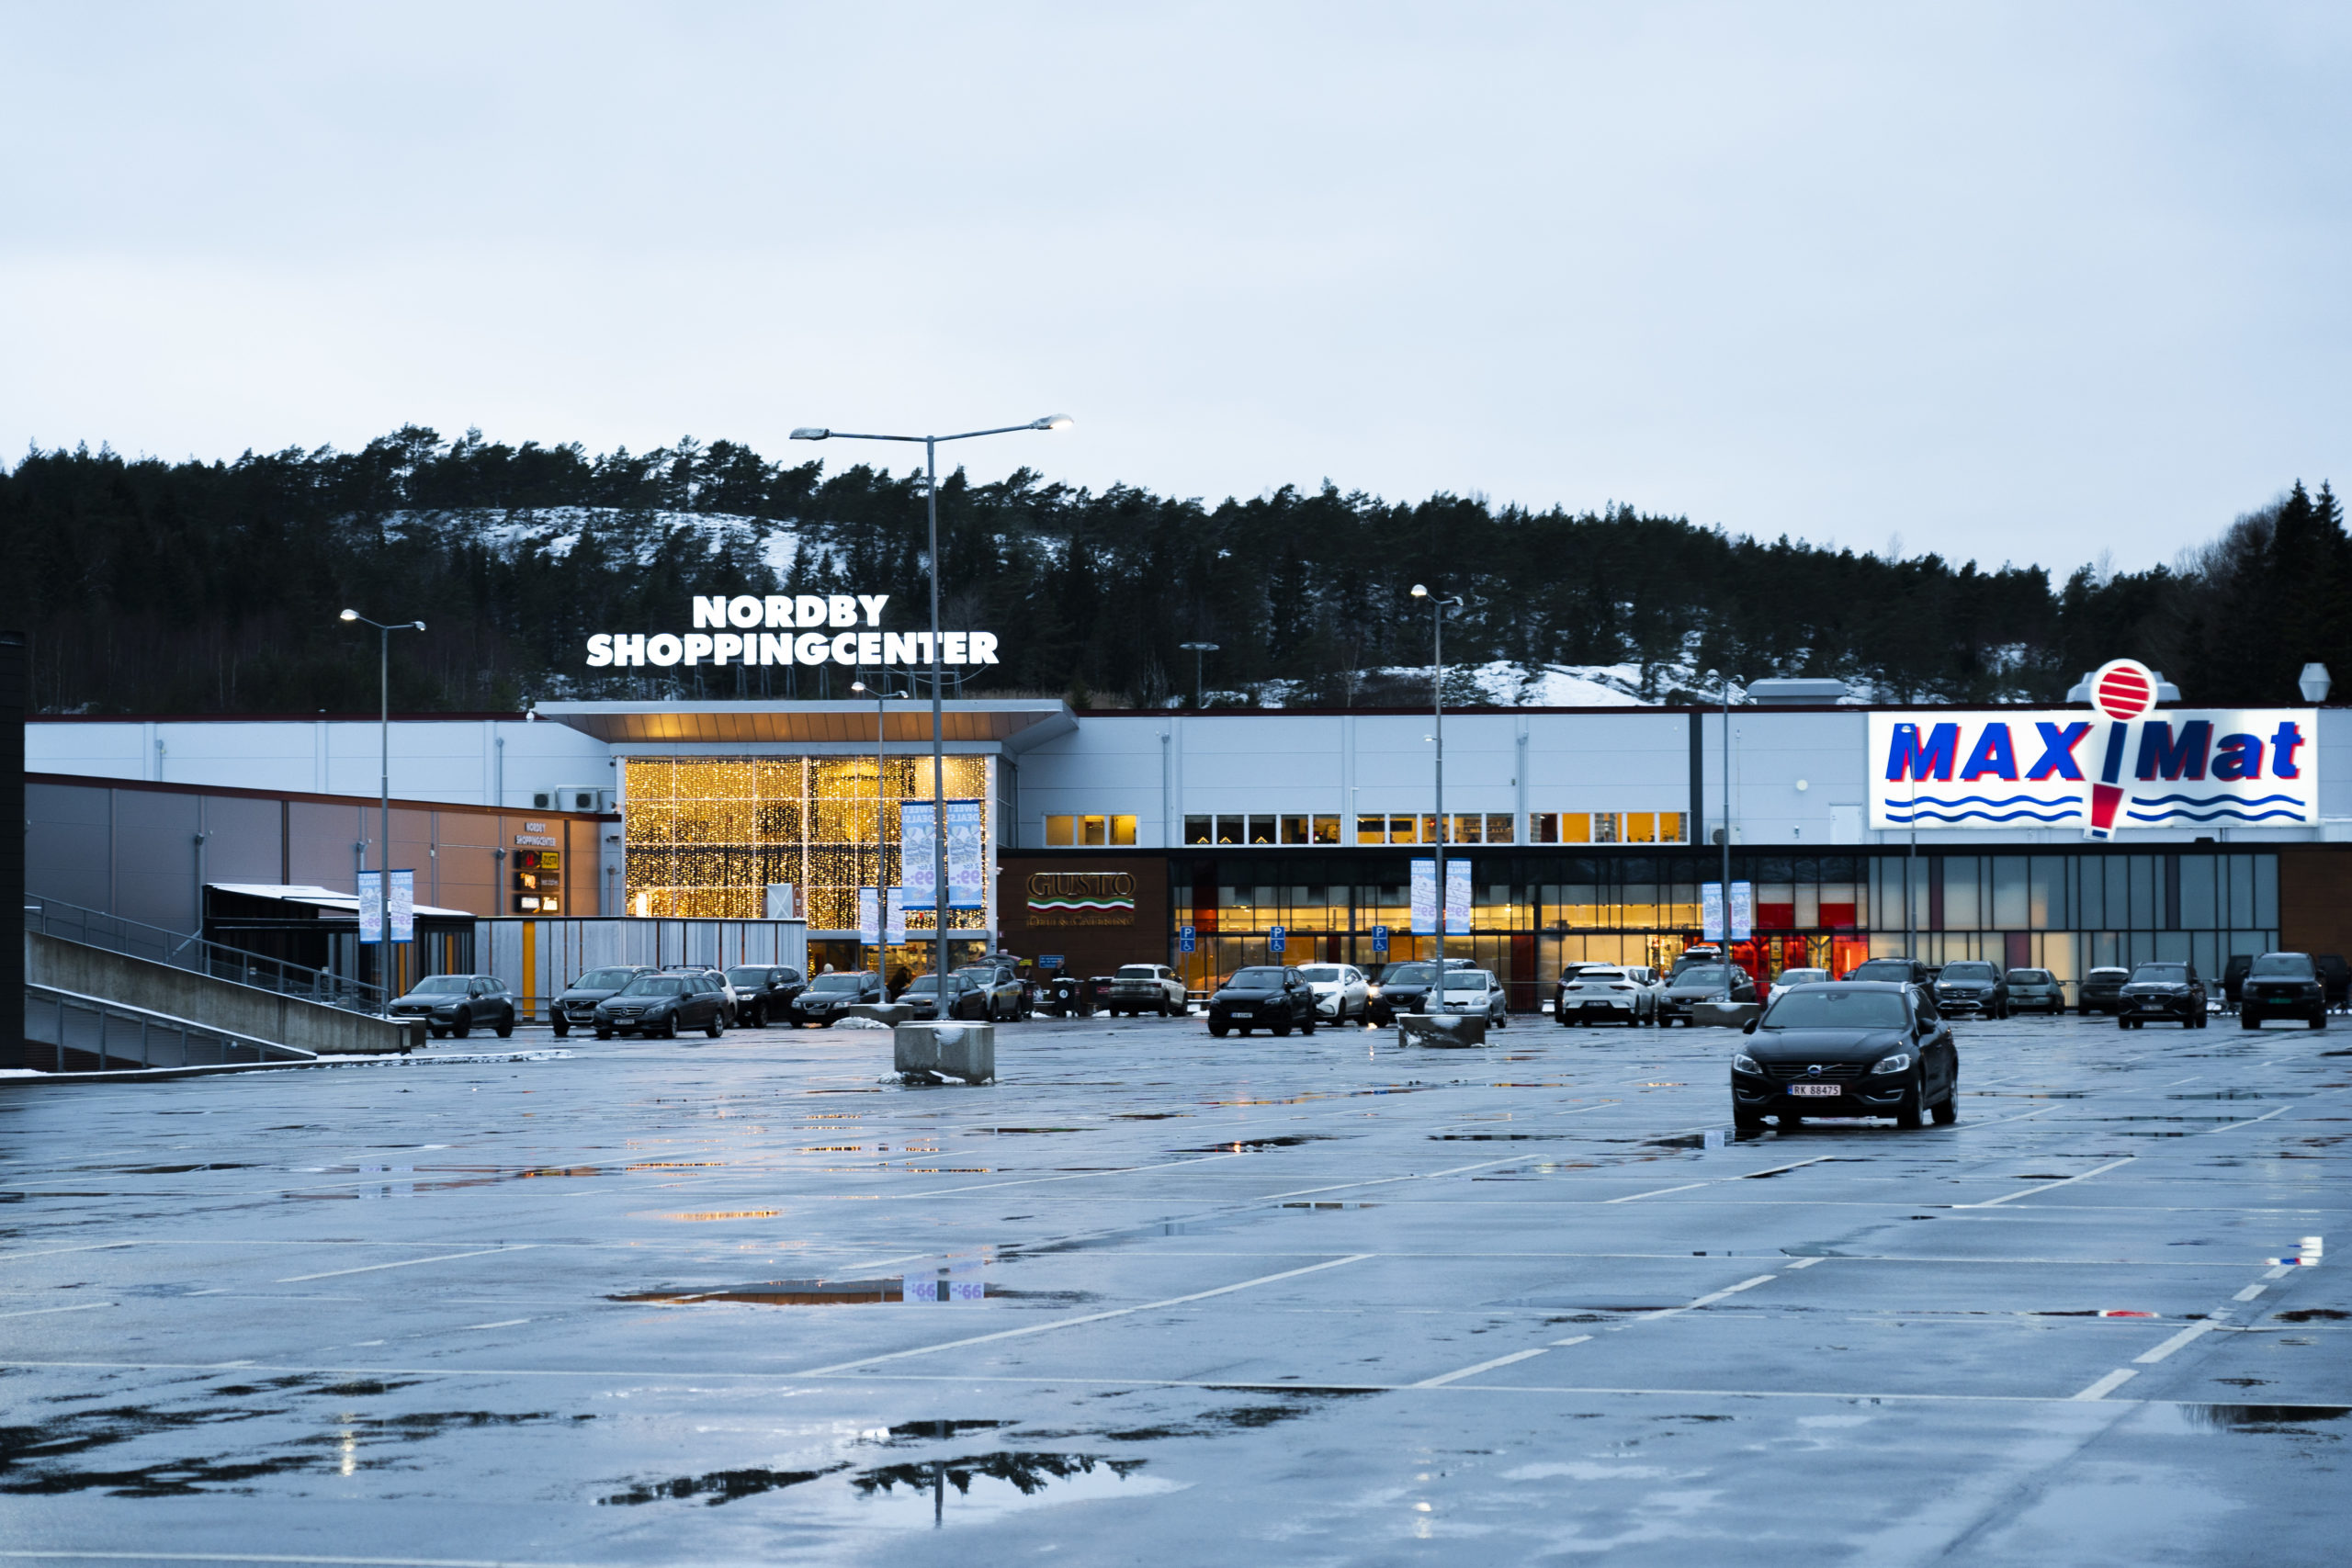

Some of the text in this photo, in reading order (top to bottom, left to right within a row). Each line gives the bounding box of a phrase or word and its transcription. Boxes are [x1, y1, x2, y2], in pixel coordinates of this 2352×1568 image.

[693, 595, 889, 627] NORDBY
[586, 632, 1000, 666] SHOPPINGCENTER
[1027, 872, 1136, 896] GUSTO
[1184, 928, 1192, 937] P
[1274, 928, 1282, 937] P
[1376, 927, 1384, 936] P
[1794, 1086, 1838, 1095] RK 88475
